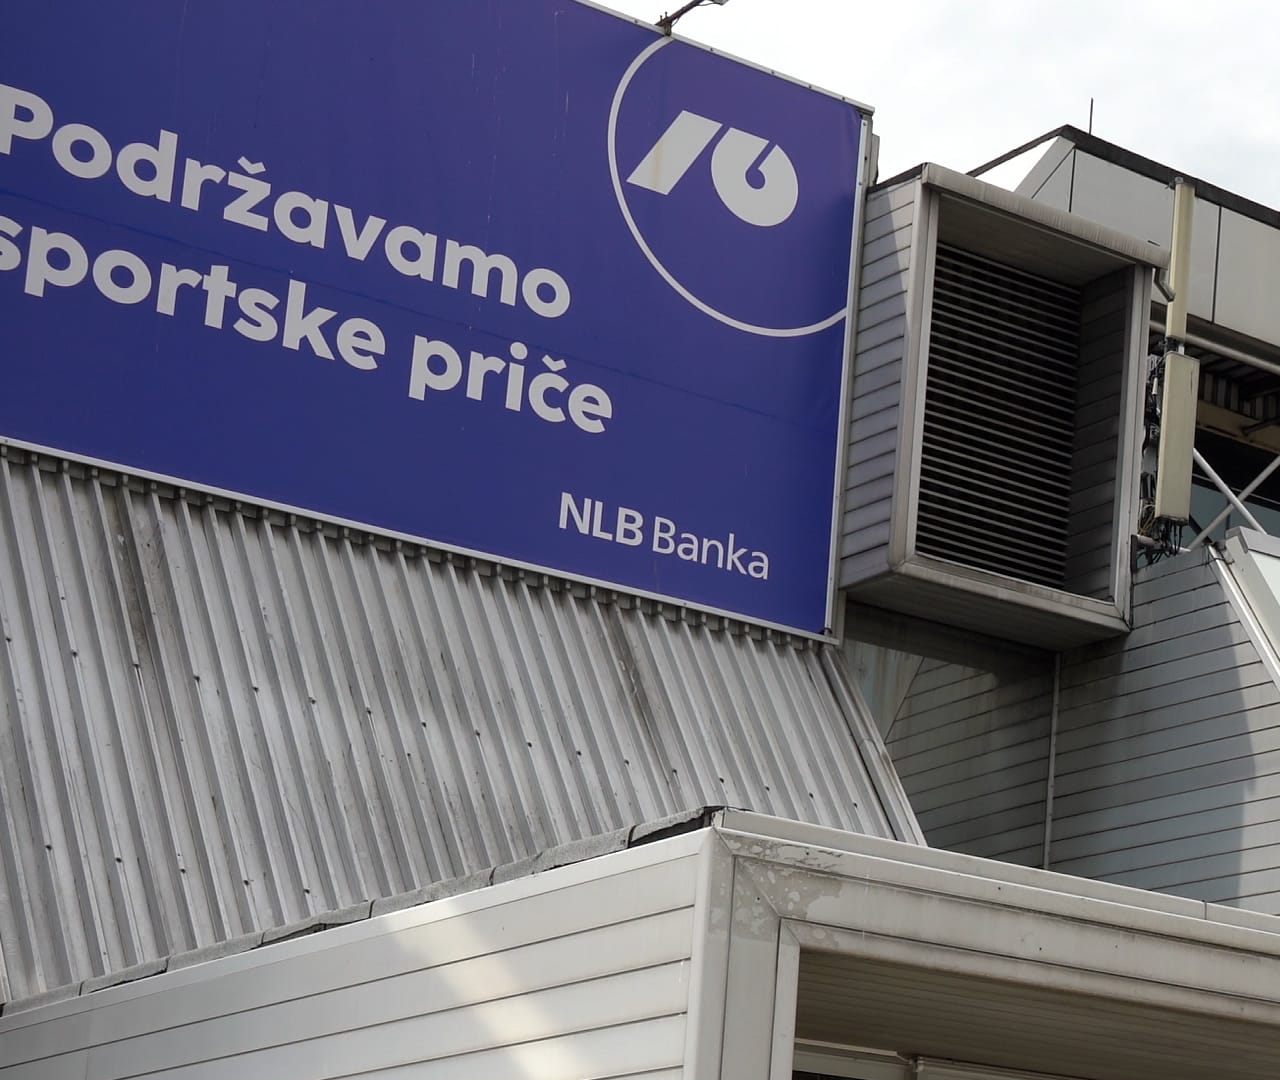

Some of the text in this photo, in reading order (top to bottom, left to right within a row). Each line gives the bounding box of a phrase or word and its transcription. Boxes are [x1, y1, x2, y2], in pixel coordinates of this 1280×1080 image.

[0, 84, 571, 318] Podržavamo
[408, 334, 613, 434] priče
[559, 492, 769, 580] NLB Banka
